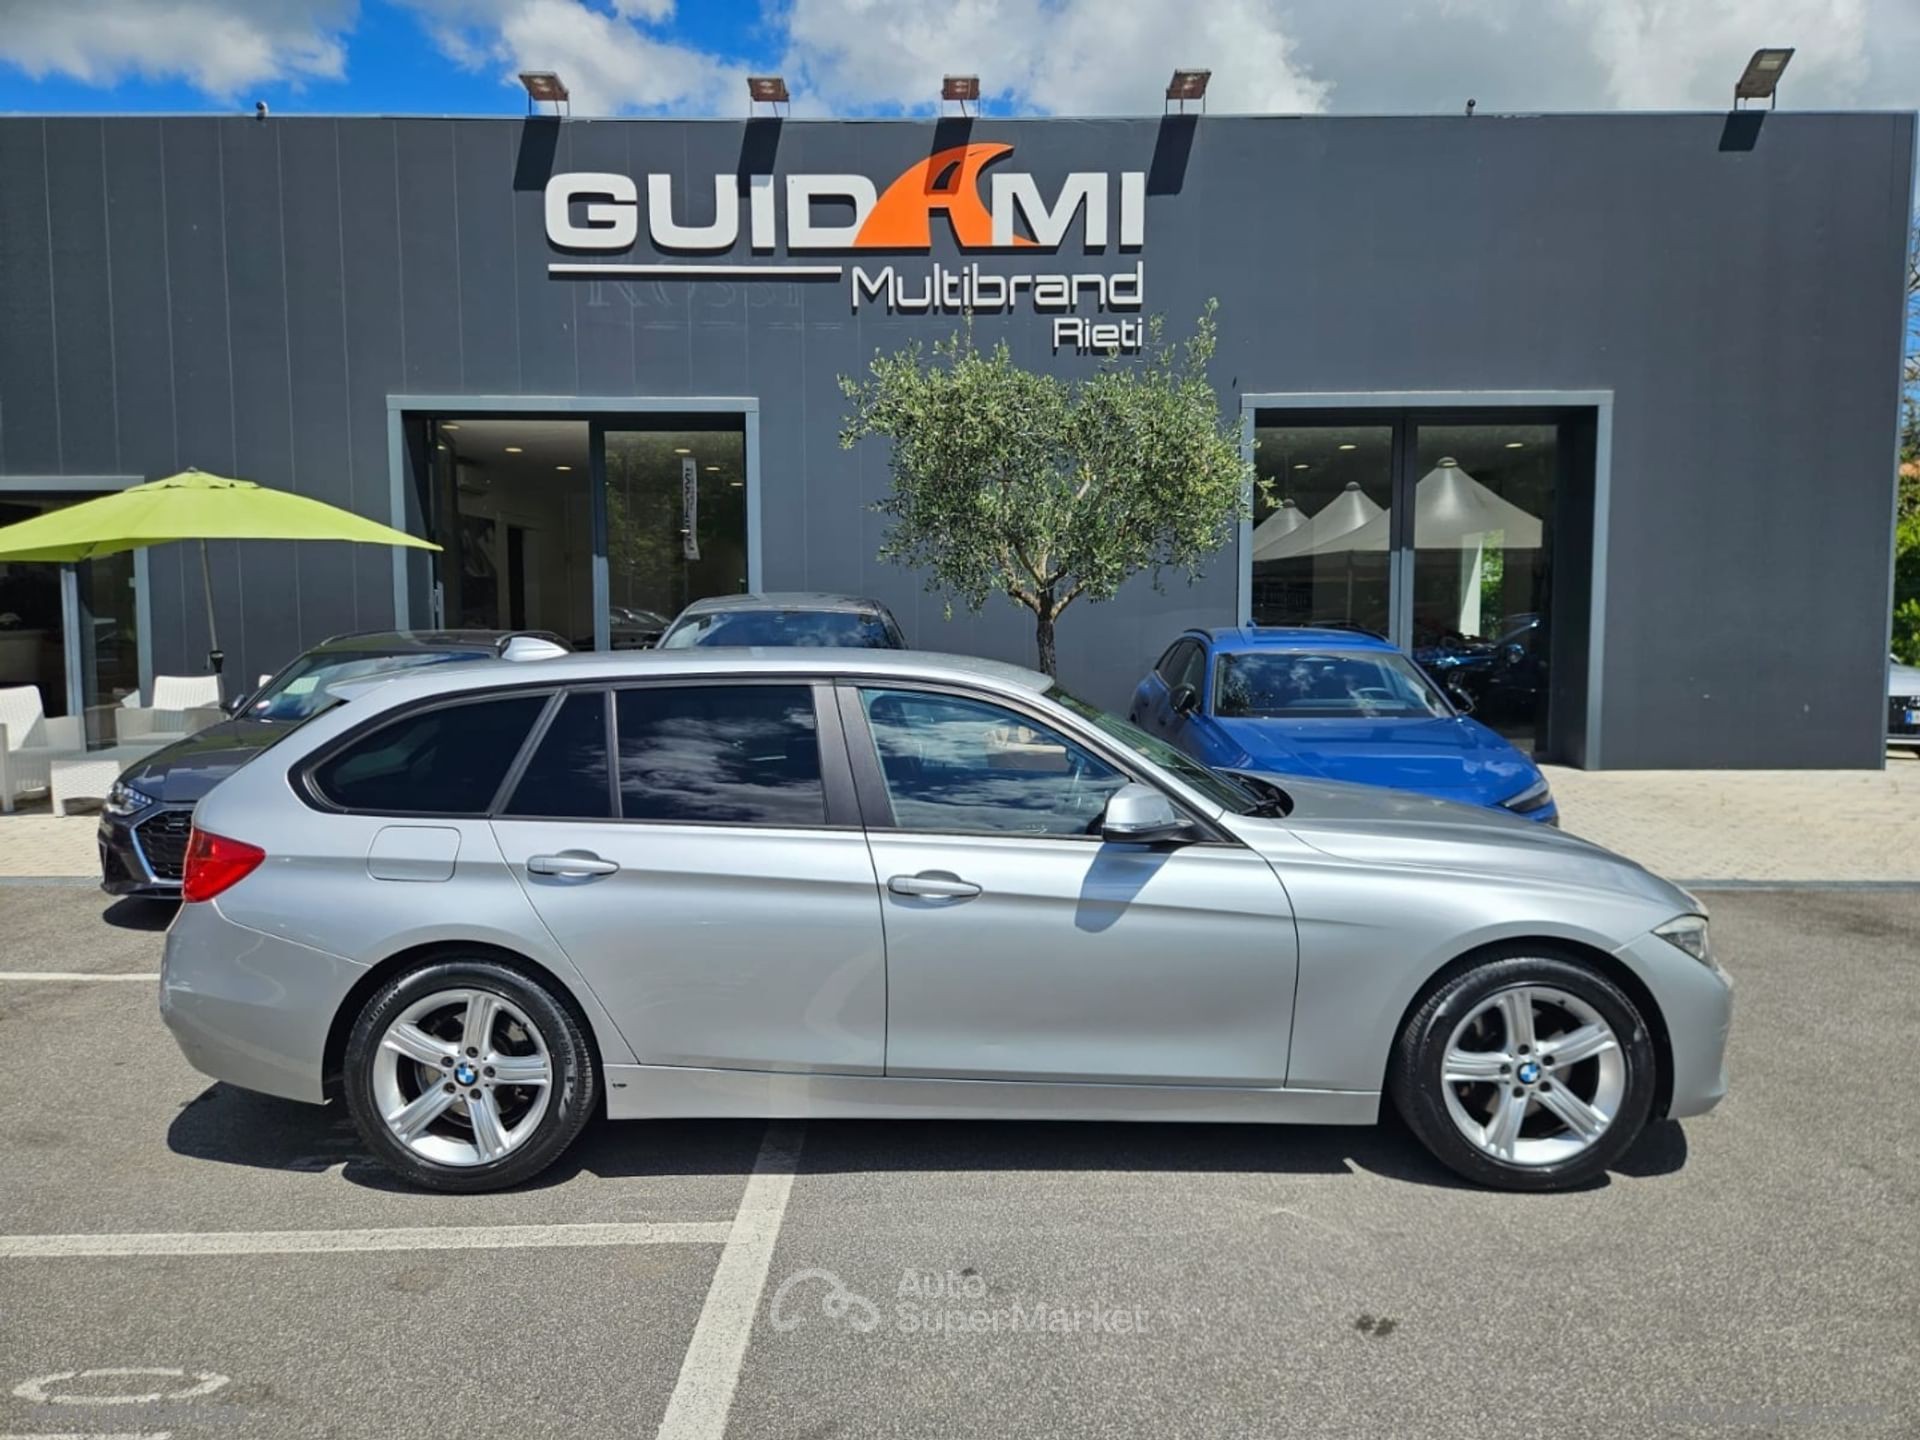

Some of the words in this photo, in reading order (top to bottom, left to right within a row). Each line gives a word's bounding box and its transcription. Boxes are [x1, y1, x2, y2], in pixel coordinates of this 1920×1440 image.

[545, 143, 1145, 249] GUIDAMI
[851, 261, 1144, 312] Multibrand
[1053, 317, 1143, 349] Rieti
